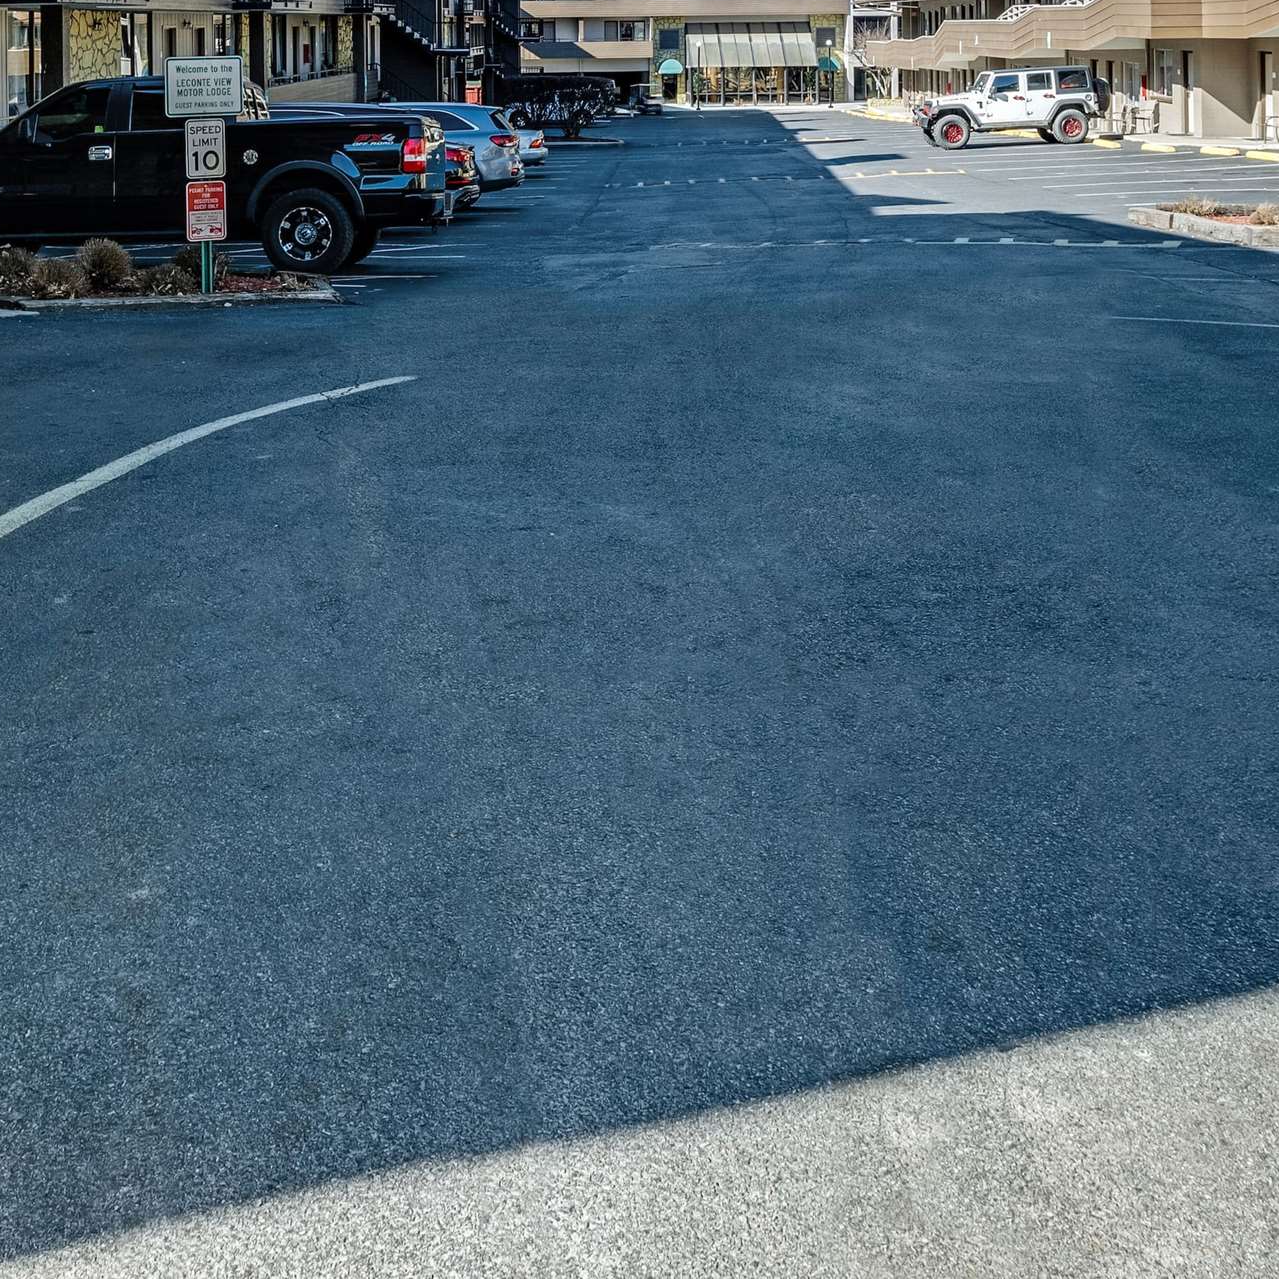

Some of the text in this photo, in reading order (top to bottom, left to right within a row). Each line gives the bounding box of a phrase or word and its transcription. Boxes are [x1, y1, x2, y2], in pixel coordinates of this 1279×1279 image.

[175, 64, 233, 74] Welcome to the
[176, 77, 232, 87] LECONTE VIEW
[177, 87, 232, 97] MOTOR LODGE
[189, 125, 221, 135] SPEED
[192, 138, 219, 147] LIMIT
[192, 150, 220, 171] 10
